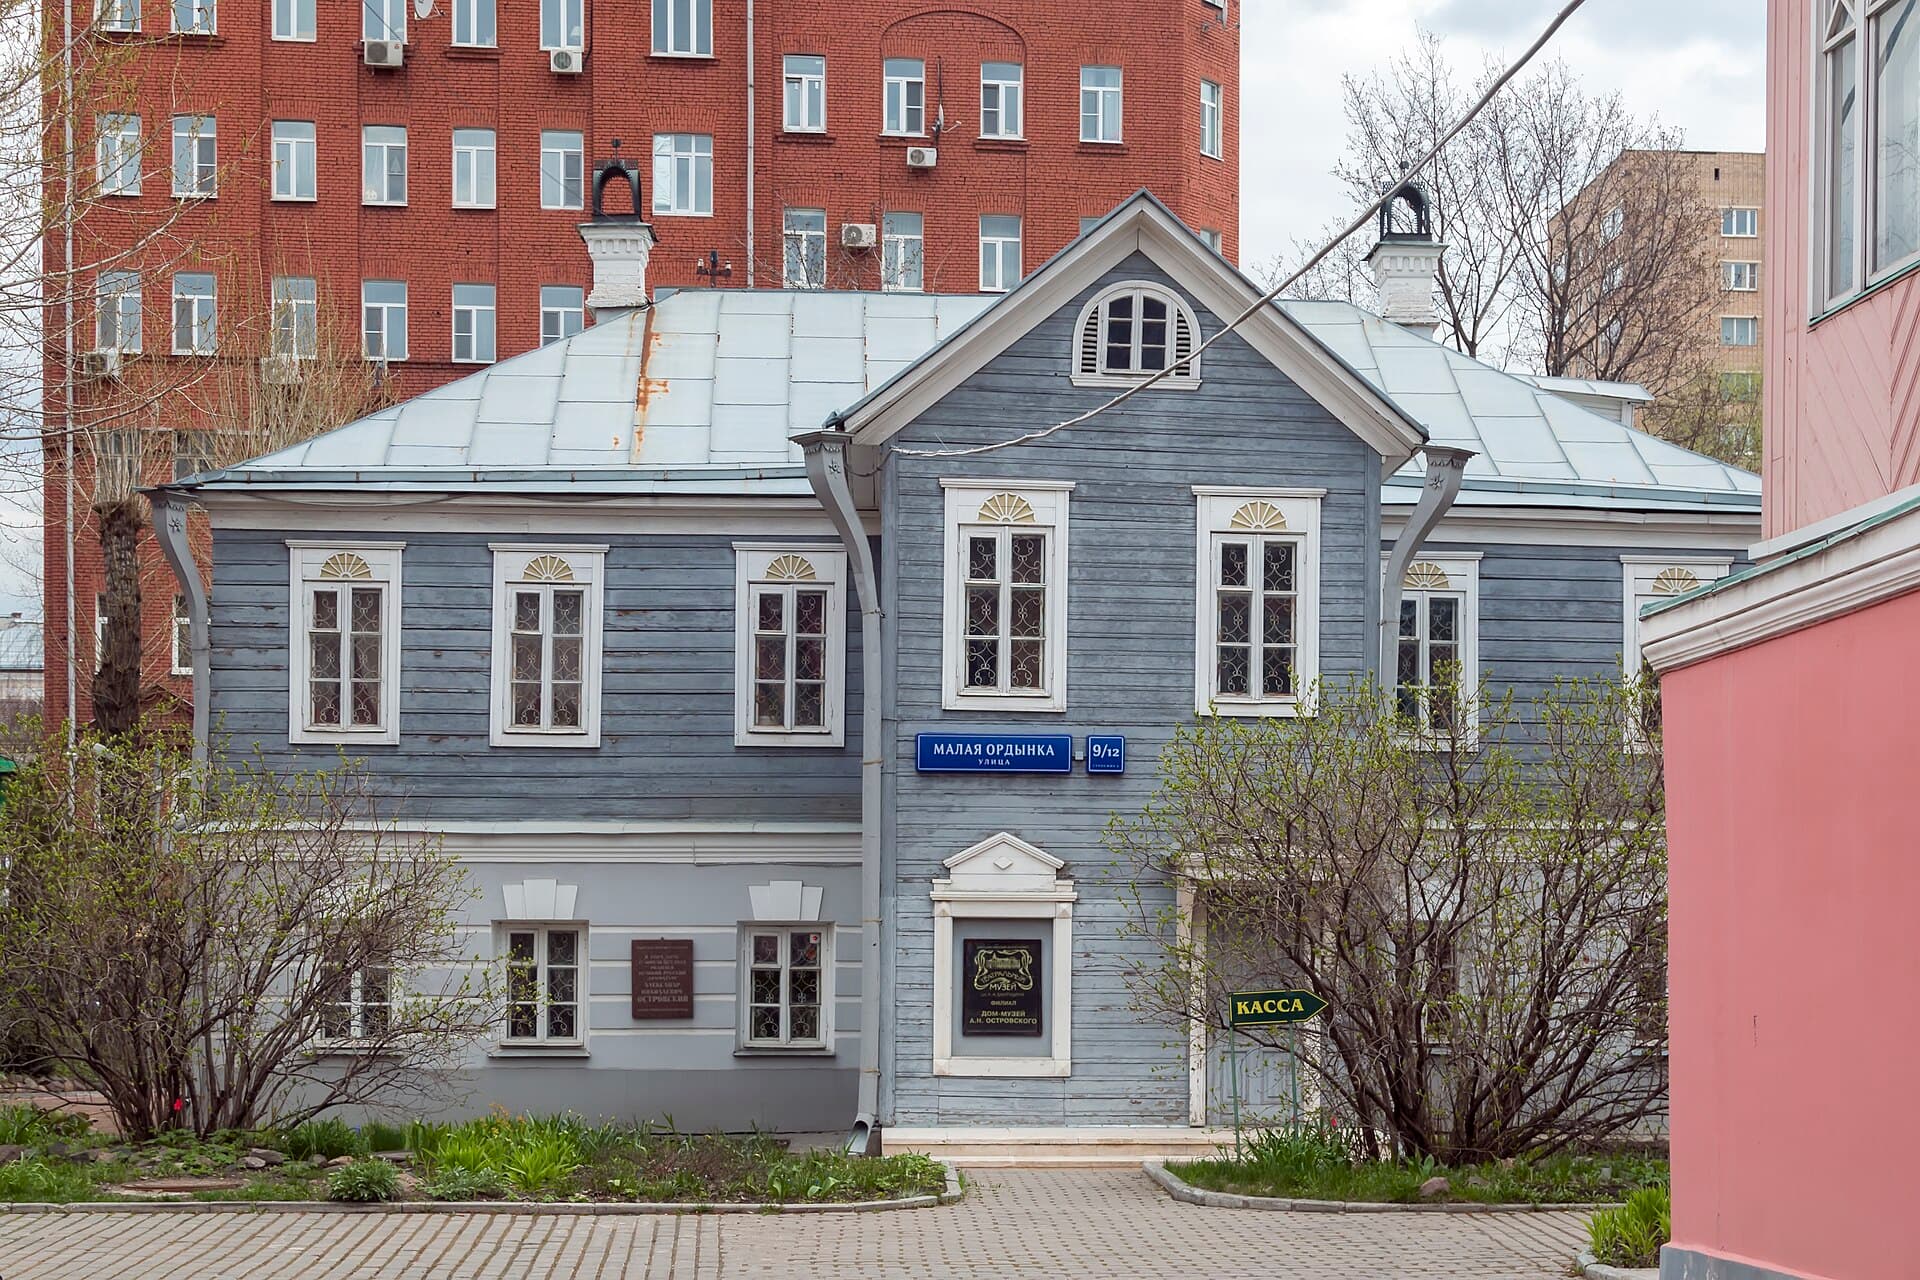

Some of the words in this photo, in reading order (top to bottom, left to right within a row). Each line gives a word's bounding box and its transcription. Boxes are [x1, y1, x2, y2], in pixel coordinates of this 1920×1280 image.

[933, 743, 982, 755] МАЛАЯ
[986, 743, 1055, 757] ОРДЫНКА
[1092, 743, 1120, 759] 9/12
[978, 758, 1011, 766] УЛИЦА
[989, 983, 1017, 991] МУЗЕЙ
[1236, 998, 1305, 1015] КАССА
